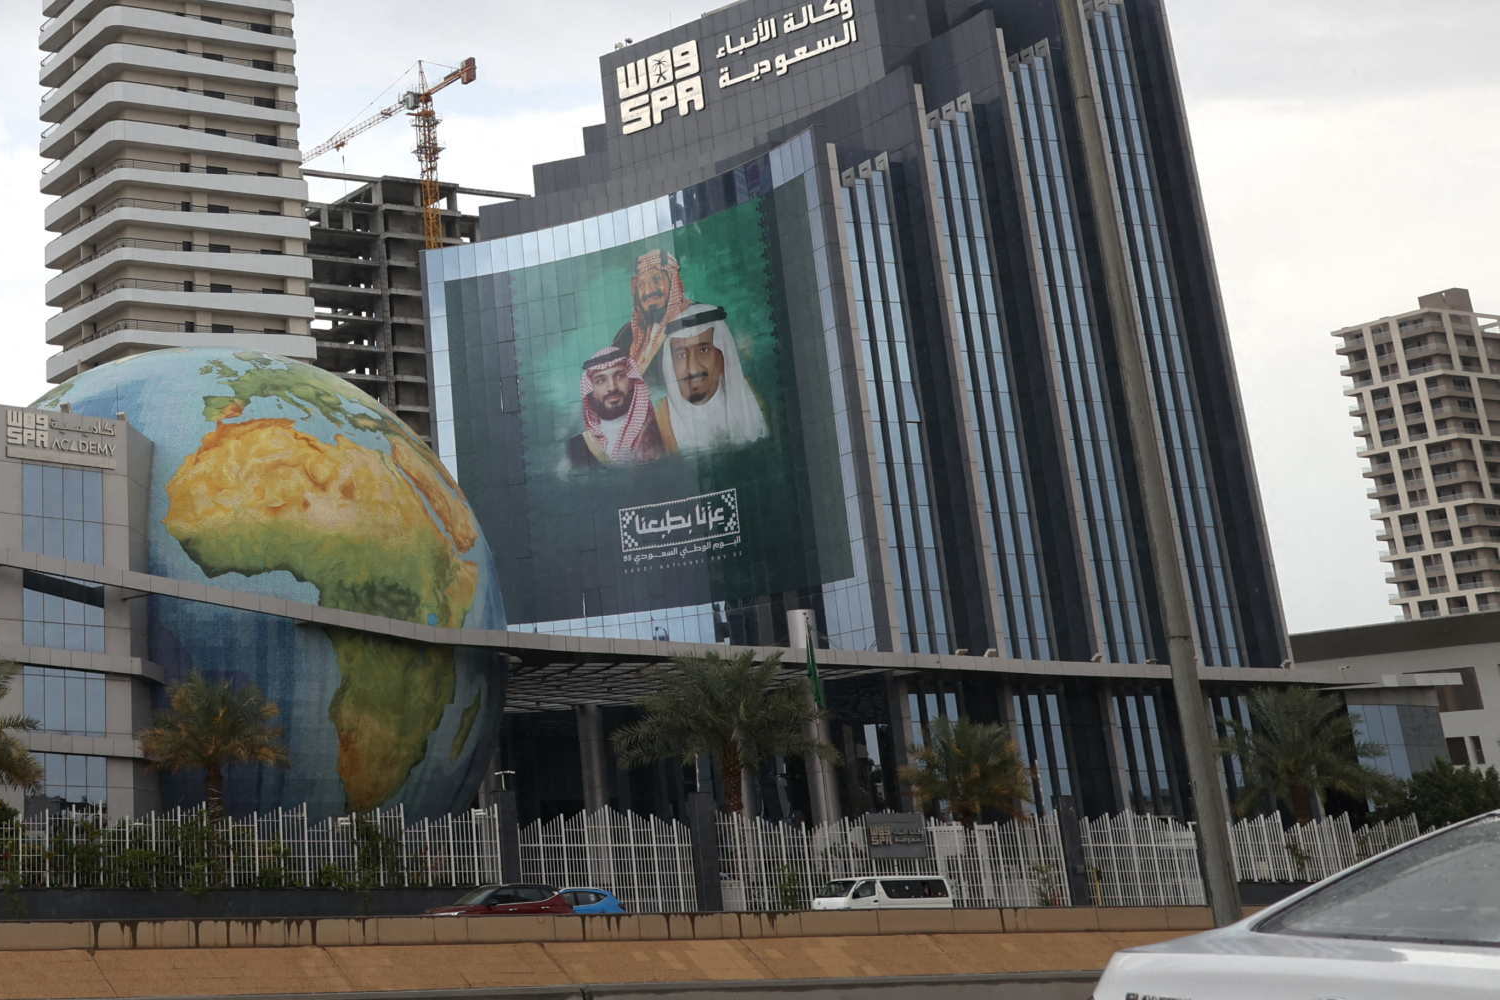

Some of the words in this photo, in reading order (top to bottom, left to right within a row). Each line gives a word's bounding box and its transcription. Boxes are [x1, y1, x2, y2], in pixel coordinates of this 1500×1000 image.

[716, 17, 778, 60] الأنباء
[718, 20, 858, 89] السعودية
[620, 76, 705, 136] SPA
[7, 427, 48, 448] SPA
[51, 438, 116, 456] ACADEMY
[679, 542, 711, 558] الوطني
[713, 536, 741, 550] اليوم
[634, 548, 678, 564] السعودي
[624, 566, 653, 574] SAUDI
[660, 558, 705, 569] NATIONAL
[871, 836, 892, 845] SPA
